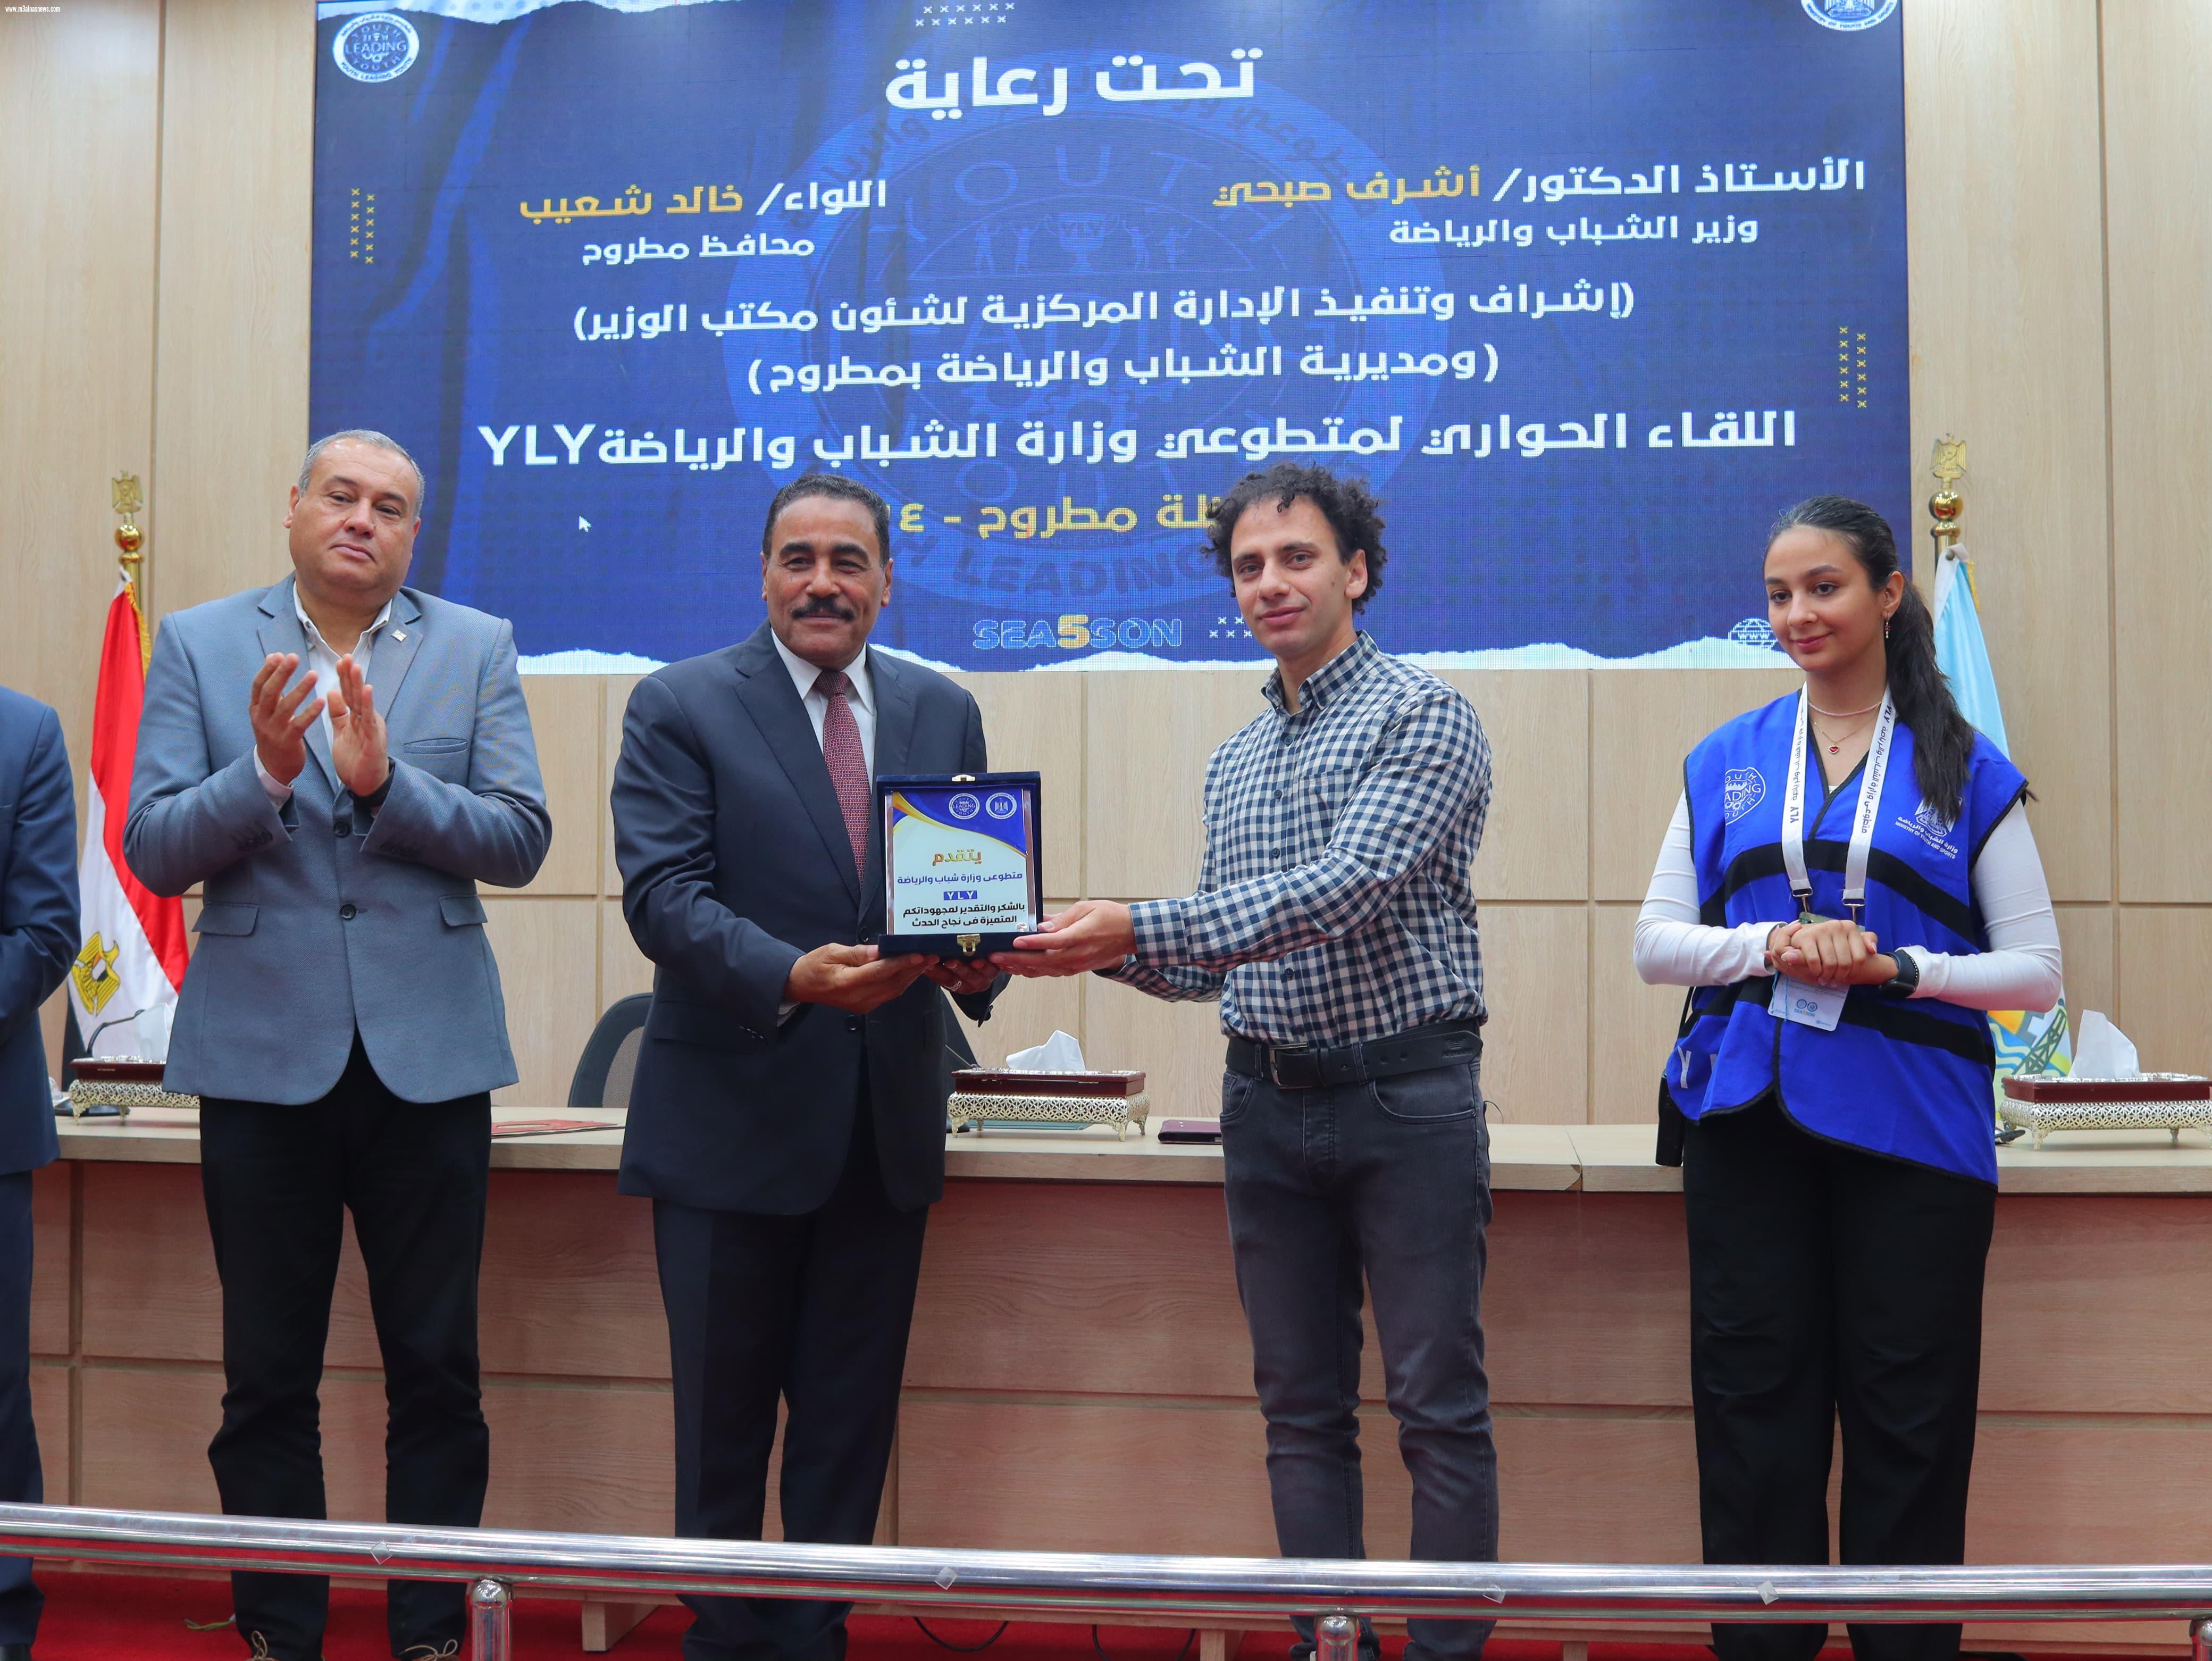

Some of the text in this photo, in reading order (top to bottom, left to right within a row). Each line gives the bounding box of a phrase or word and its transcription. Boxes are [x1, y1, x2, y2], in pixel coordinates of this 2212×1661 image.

[346, 40, 407, 54] LEADING
[885, 47, 1263, 120] تحت رعاية
[1347, 165, 1479, 204] أشرف
[1696, 157, 1864, 193] الأستاذ
[520, 185, 652, 224] شعيب
[666, 185, 743, 213] خالد
[1213, 182, 1331, 207] صبحي
[1389, 214, 1757, 247] وزير الشباب والرياضة
[582, 233, 815, 265] محافظ مطروح
[701, 302, 818, 337] مكتب
[982, 291, 1158, 329] المركزية
[1174, 286, 1299, 325] الإدارة
[1314, 286, 1454, 322] وتنفيذ
[937, 350, 1108, 387] والرياضة
[1125, 343, 1281, 385] الشباب
[814, 419, 996, 468] الشباب
[1016, 421, 1137, 464] وزارة
[1156, 416, 1403, 462] لمتطوعي
[1421, 413, 1627, 458] الحواري
[1648, 411, 1795, 448] اللقاء
[979, 497, 1137, 538] مطروح
[1883, 705, 1892, 724] YLY
[1724, 783, 1762, 804] ADING
[1725, 771, 1757, 783] OUTH
[1790, 806, 1799, 824] YLY
[1895, 821, 1915, 833] MINISTRY
[1939, 846, 1956, 859] SPORTS
[932, 849, 982, 866] يتقدم
[898, 875, 933, 886] والرياضة
[935, 873, 959, 884] شباب
[961, 873, 982, 883] وزارة
[903, 902, 1025, 918] بالشكر والتقدير لمجهوداتكم
[946, 891, 974, 899] YLY
[912, 917, 940, 927] الحدث
[941, 917, 961, 929] نجاح
[980, 915, 1017, 927] المتميزة
